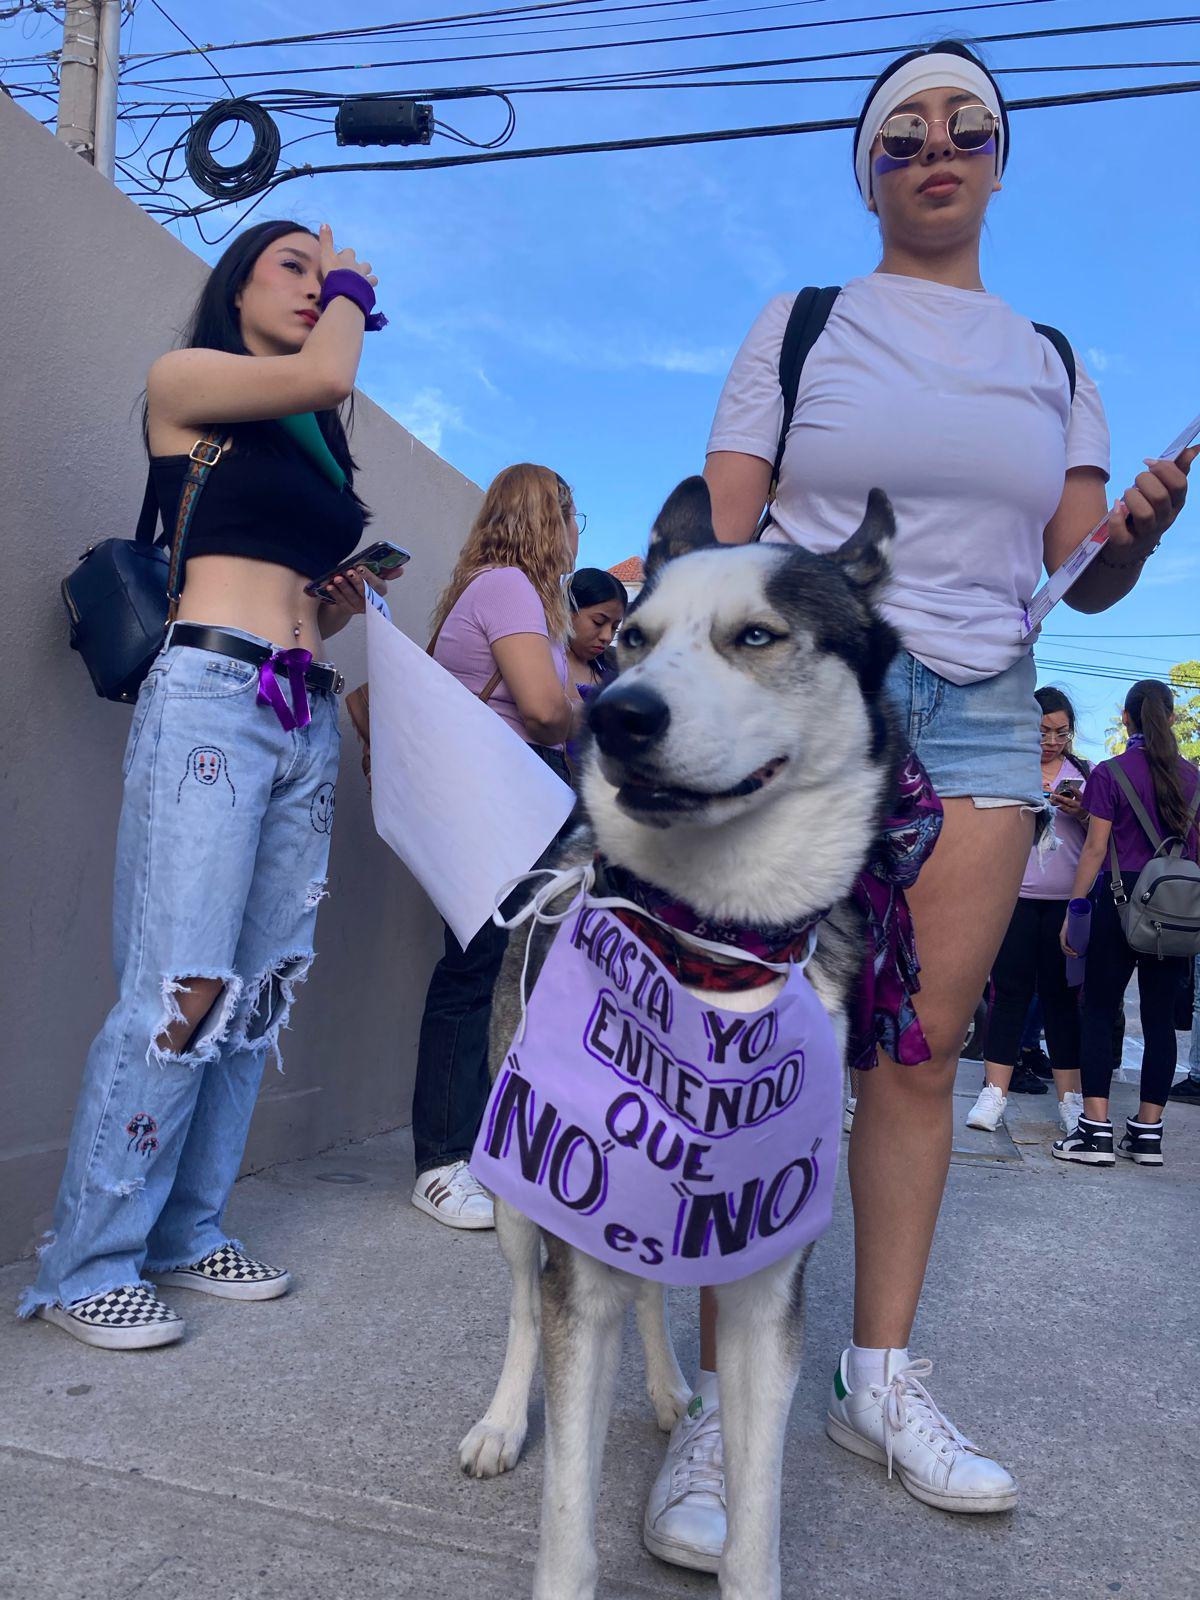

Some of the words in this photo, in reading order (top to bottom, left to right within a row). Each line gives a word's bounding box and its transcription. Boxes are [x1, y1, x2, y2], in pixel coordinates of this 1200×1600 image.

[571, 907, 673, 1034] HASTA
[702, 1008, 778, 1064] YO
[590, 997, 800, 1133] ENTIENDO
[605, 1091, 716, 1183] QUE
[604, 1212, 665, 1265] es
